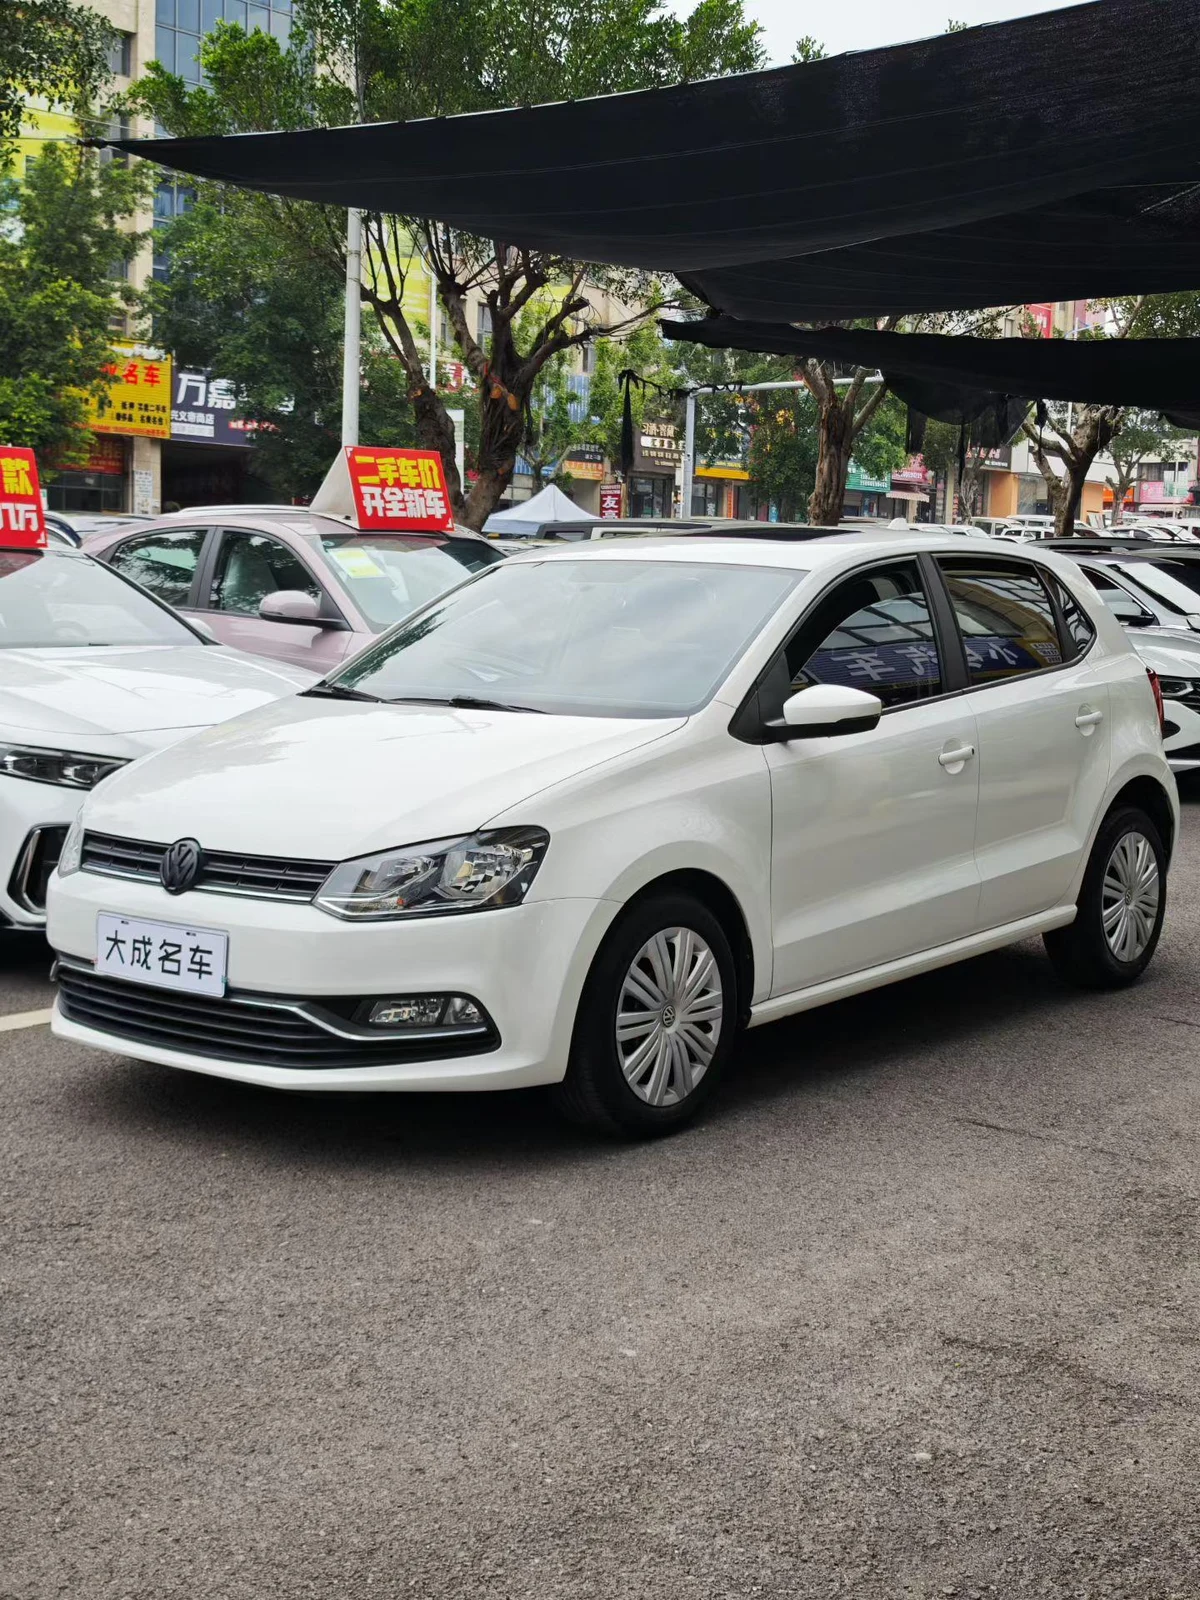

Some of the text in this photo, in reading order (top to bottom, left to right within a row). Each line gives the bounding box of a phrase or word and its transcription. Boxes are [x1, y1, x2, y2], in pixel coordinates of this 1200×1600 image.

[100, 363, 160, 387] 名车
[1, 457, 34, 496] 款
[355, 456, 441, 489] 二手车价
[360, 486, 447, 519] 开全新车
[105, 929, 213, 980] 大成名车
